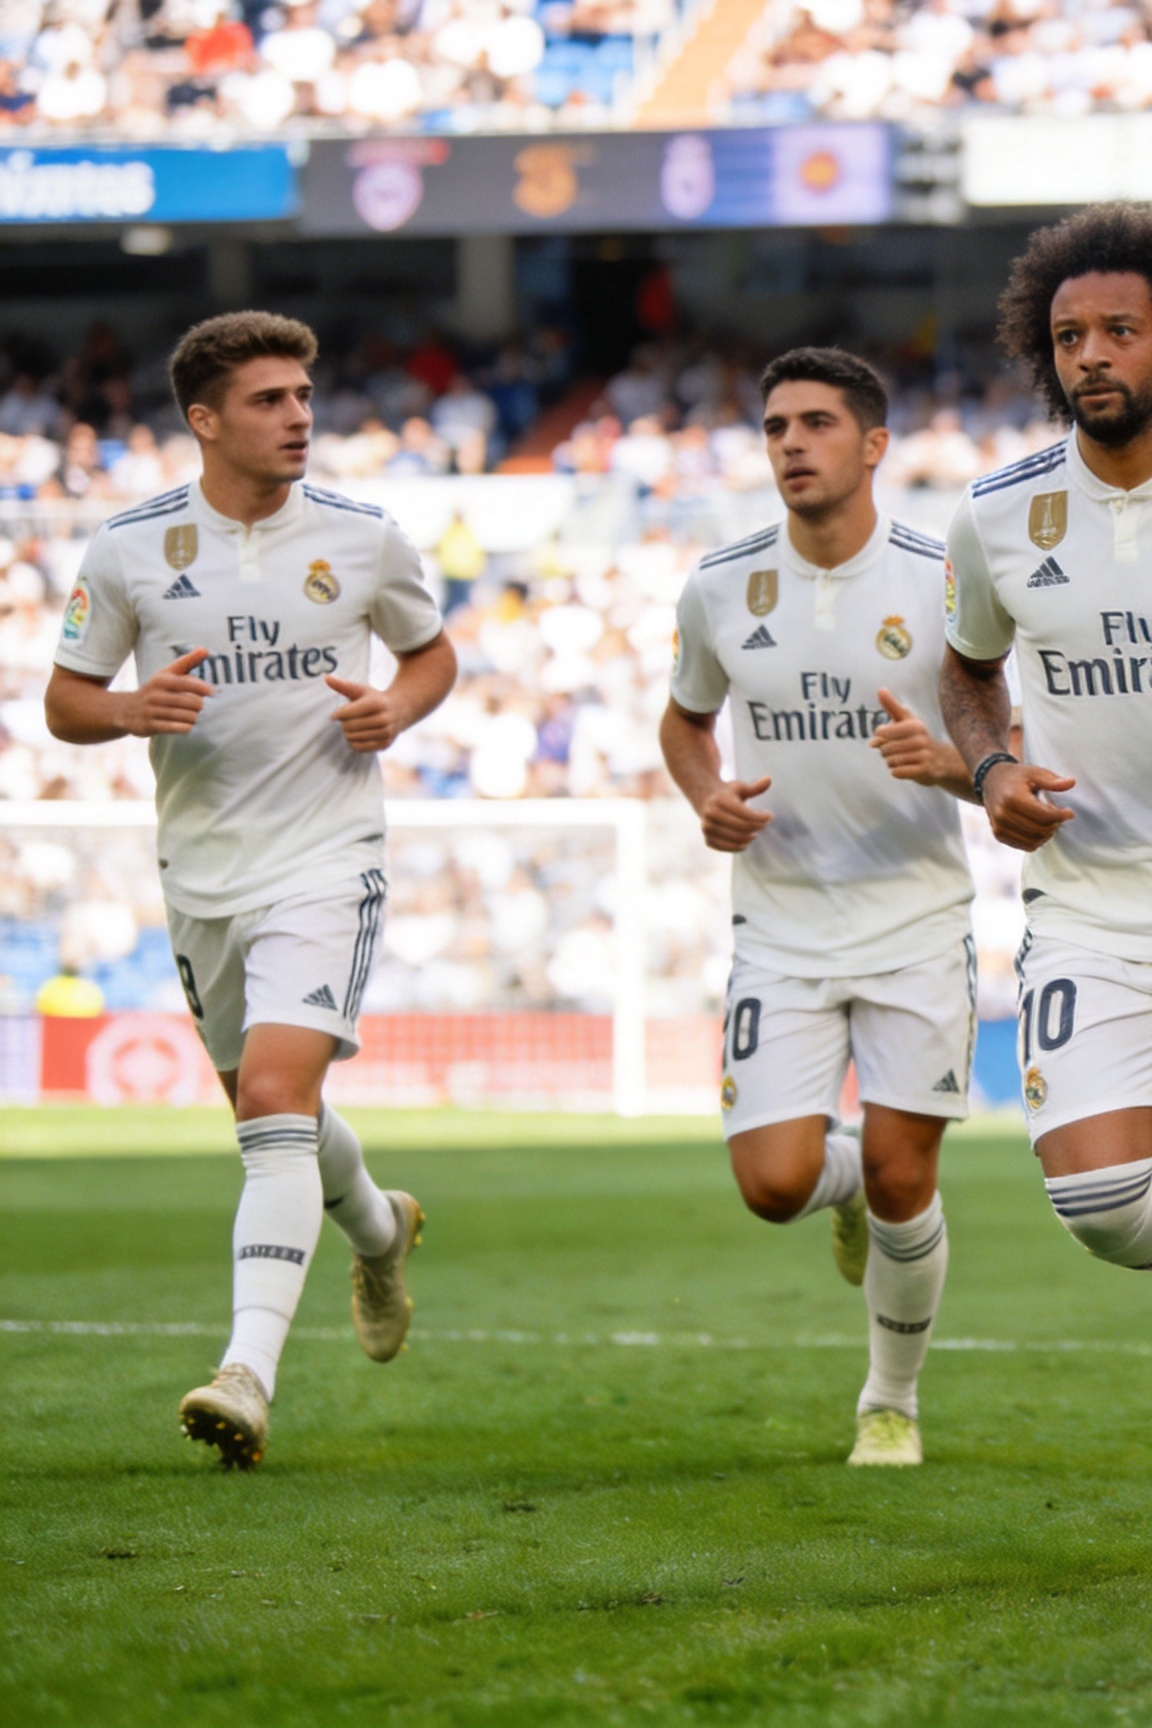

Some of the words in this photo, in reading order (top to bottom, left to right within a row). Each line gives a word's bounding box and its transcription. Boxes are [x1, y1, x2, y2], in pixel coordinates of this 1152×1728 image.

[227, 616, 280, 646] Fly
[172, 643, 338, 685] mirates
[800, 672, 851, 703] Fly
[747, 702, 892, 741] Emirate
